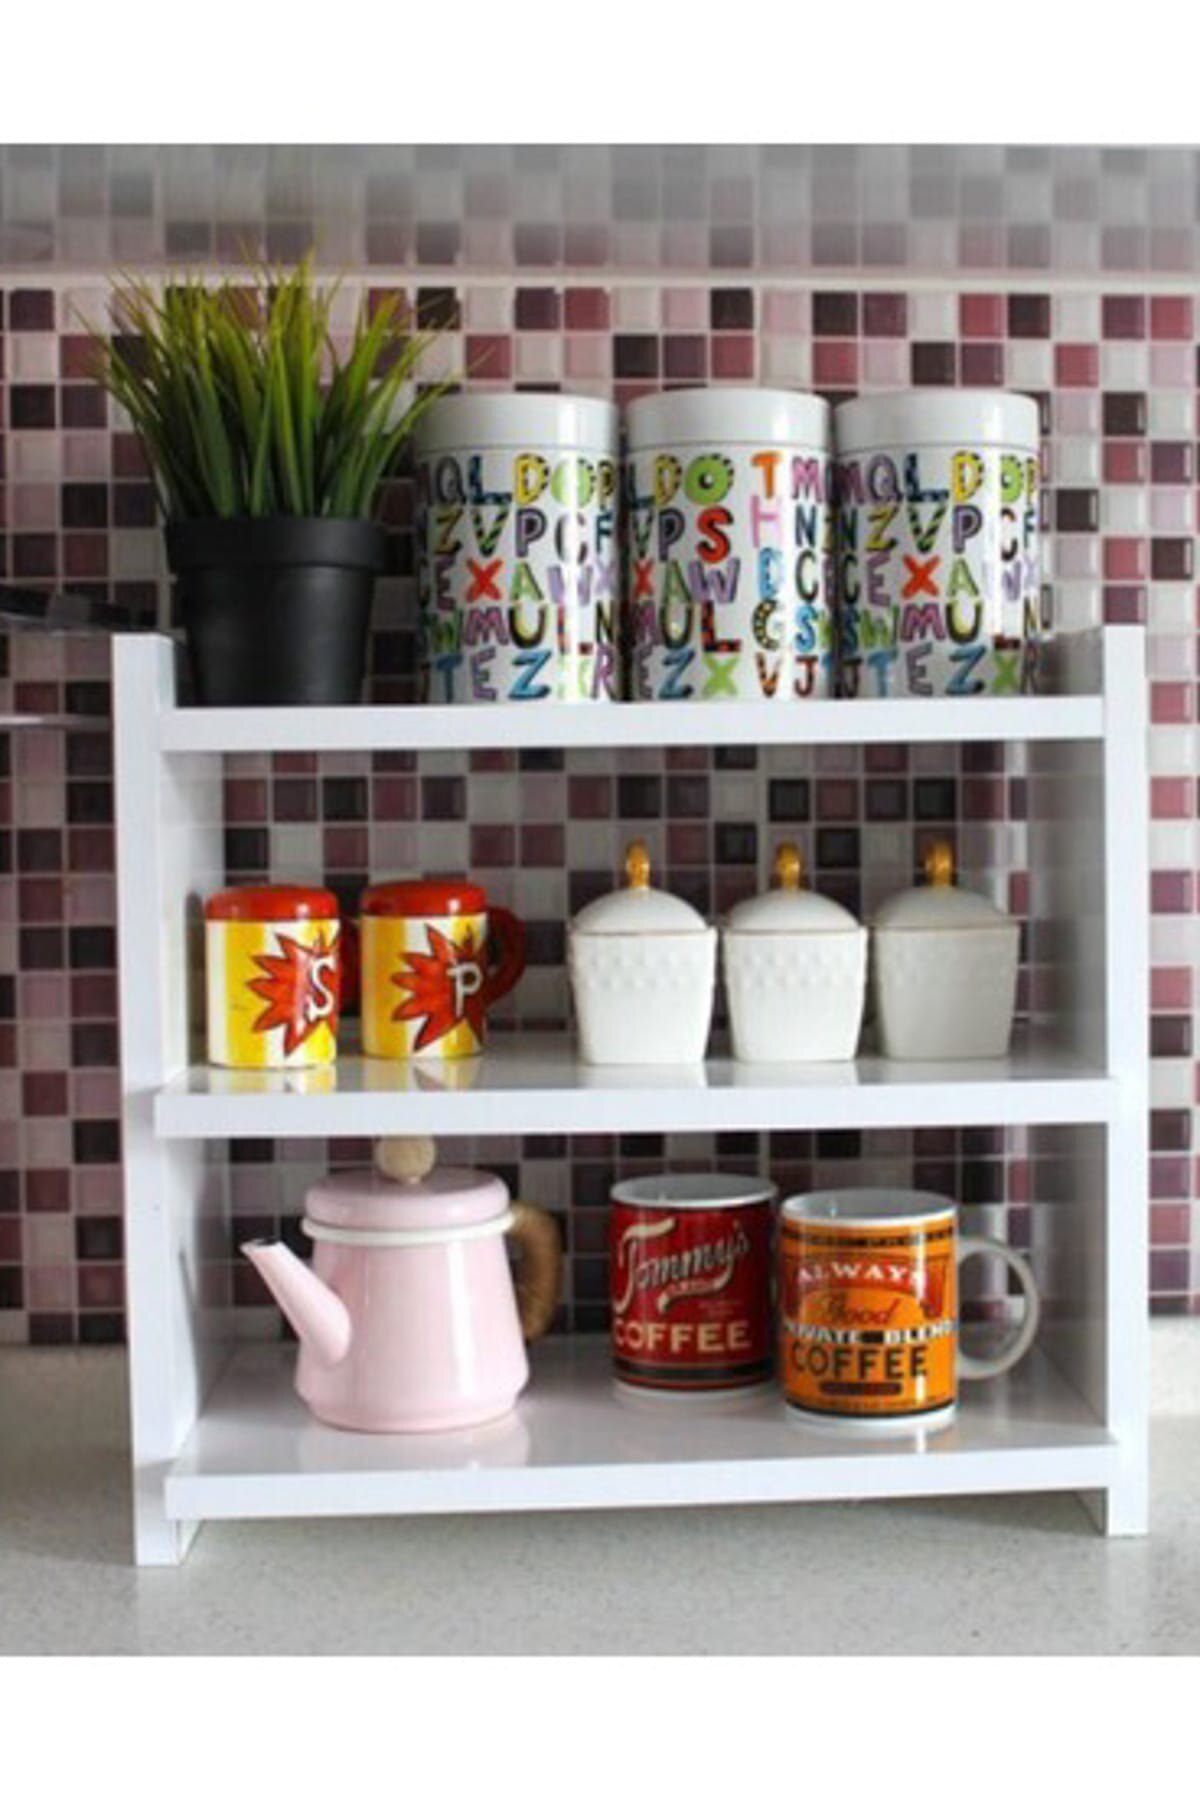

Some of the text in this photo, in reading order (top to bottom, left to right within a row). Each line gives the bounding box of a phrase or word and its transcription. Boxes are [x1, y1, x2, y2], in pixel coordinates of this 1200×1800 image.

[304, 957, 335, 1020] S
[447, 963, 483, 1020] P
[614, 1318, 751, 1353] COFFEE
[792, 1339, 928, 1380] COFFEE
